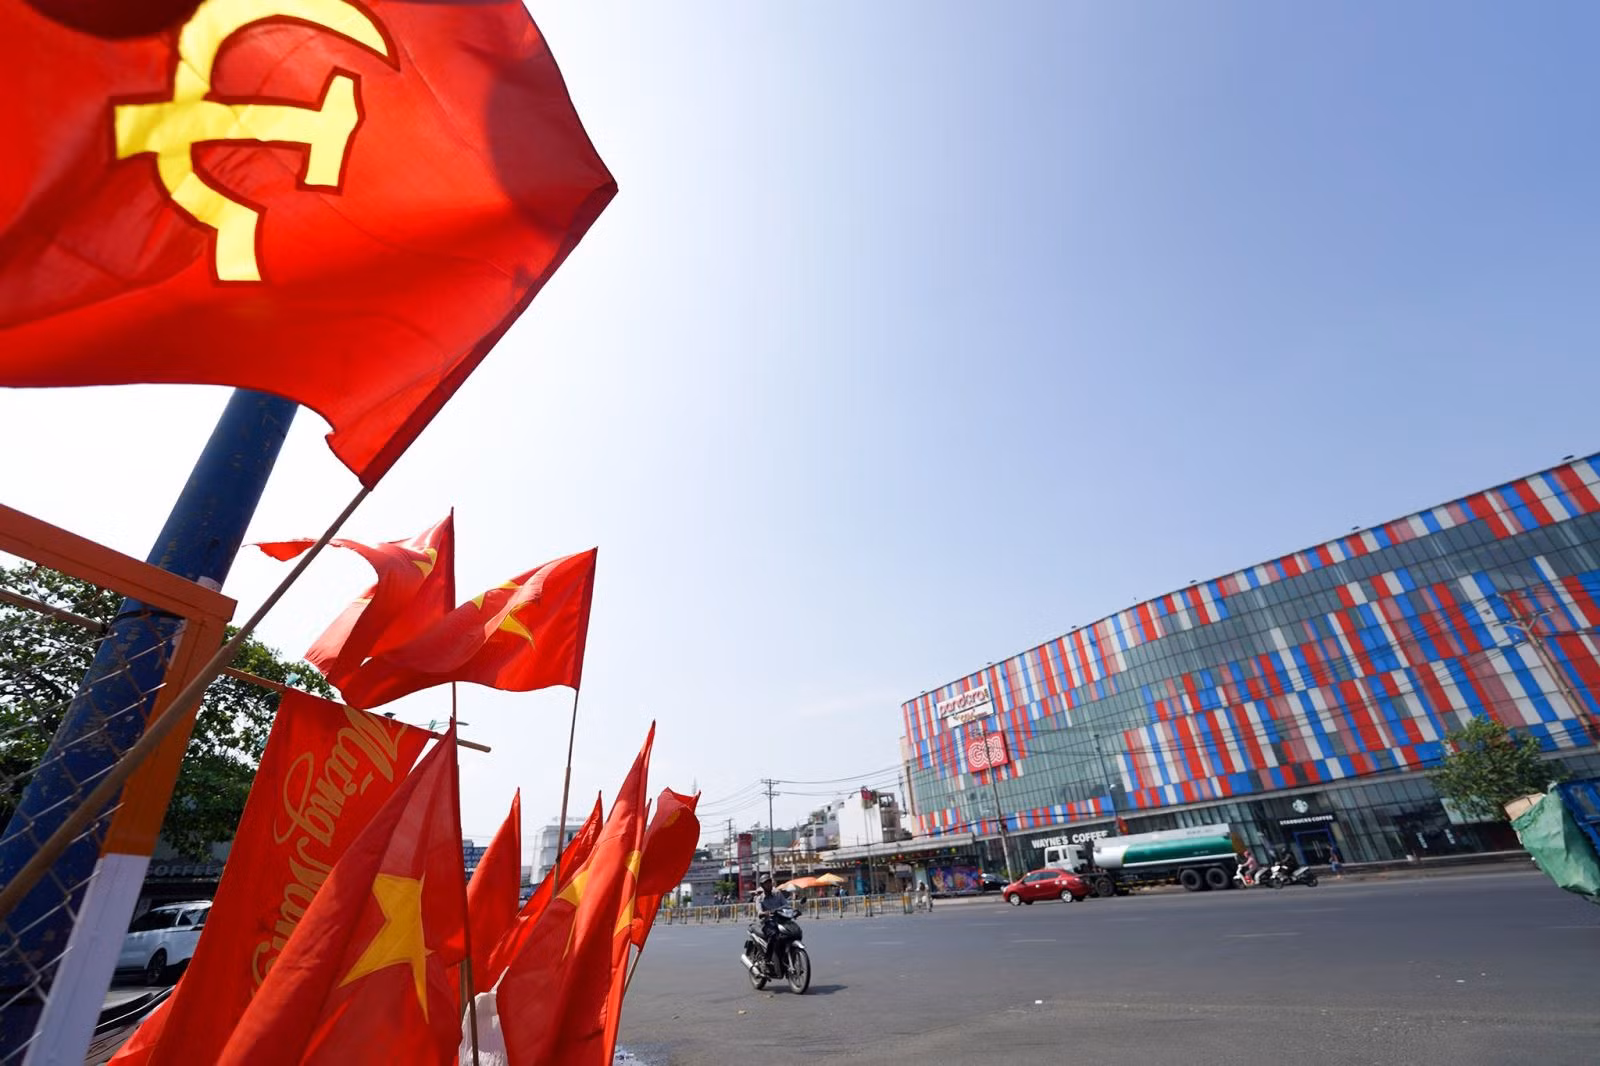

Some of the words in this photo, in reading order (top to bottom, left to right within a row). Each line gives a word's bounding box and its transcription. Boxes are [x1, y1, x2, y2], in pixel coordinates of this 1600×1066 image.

[968, 735, 1004, 768] GO!
[1279, 818, 1312, 826] STARBUCKS
[1312, 814, 1334, 822] COFFEE
[1031, 835, 1069, 849] WAYNE'S
[1072, 830, 1109, 844] COFFEE
